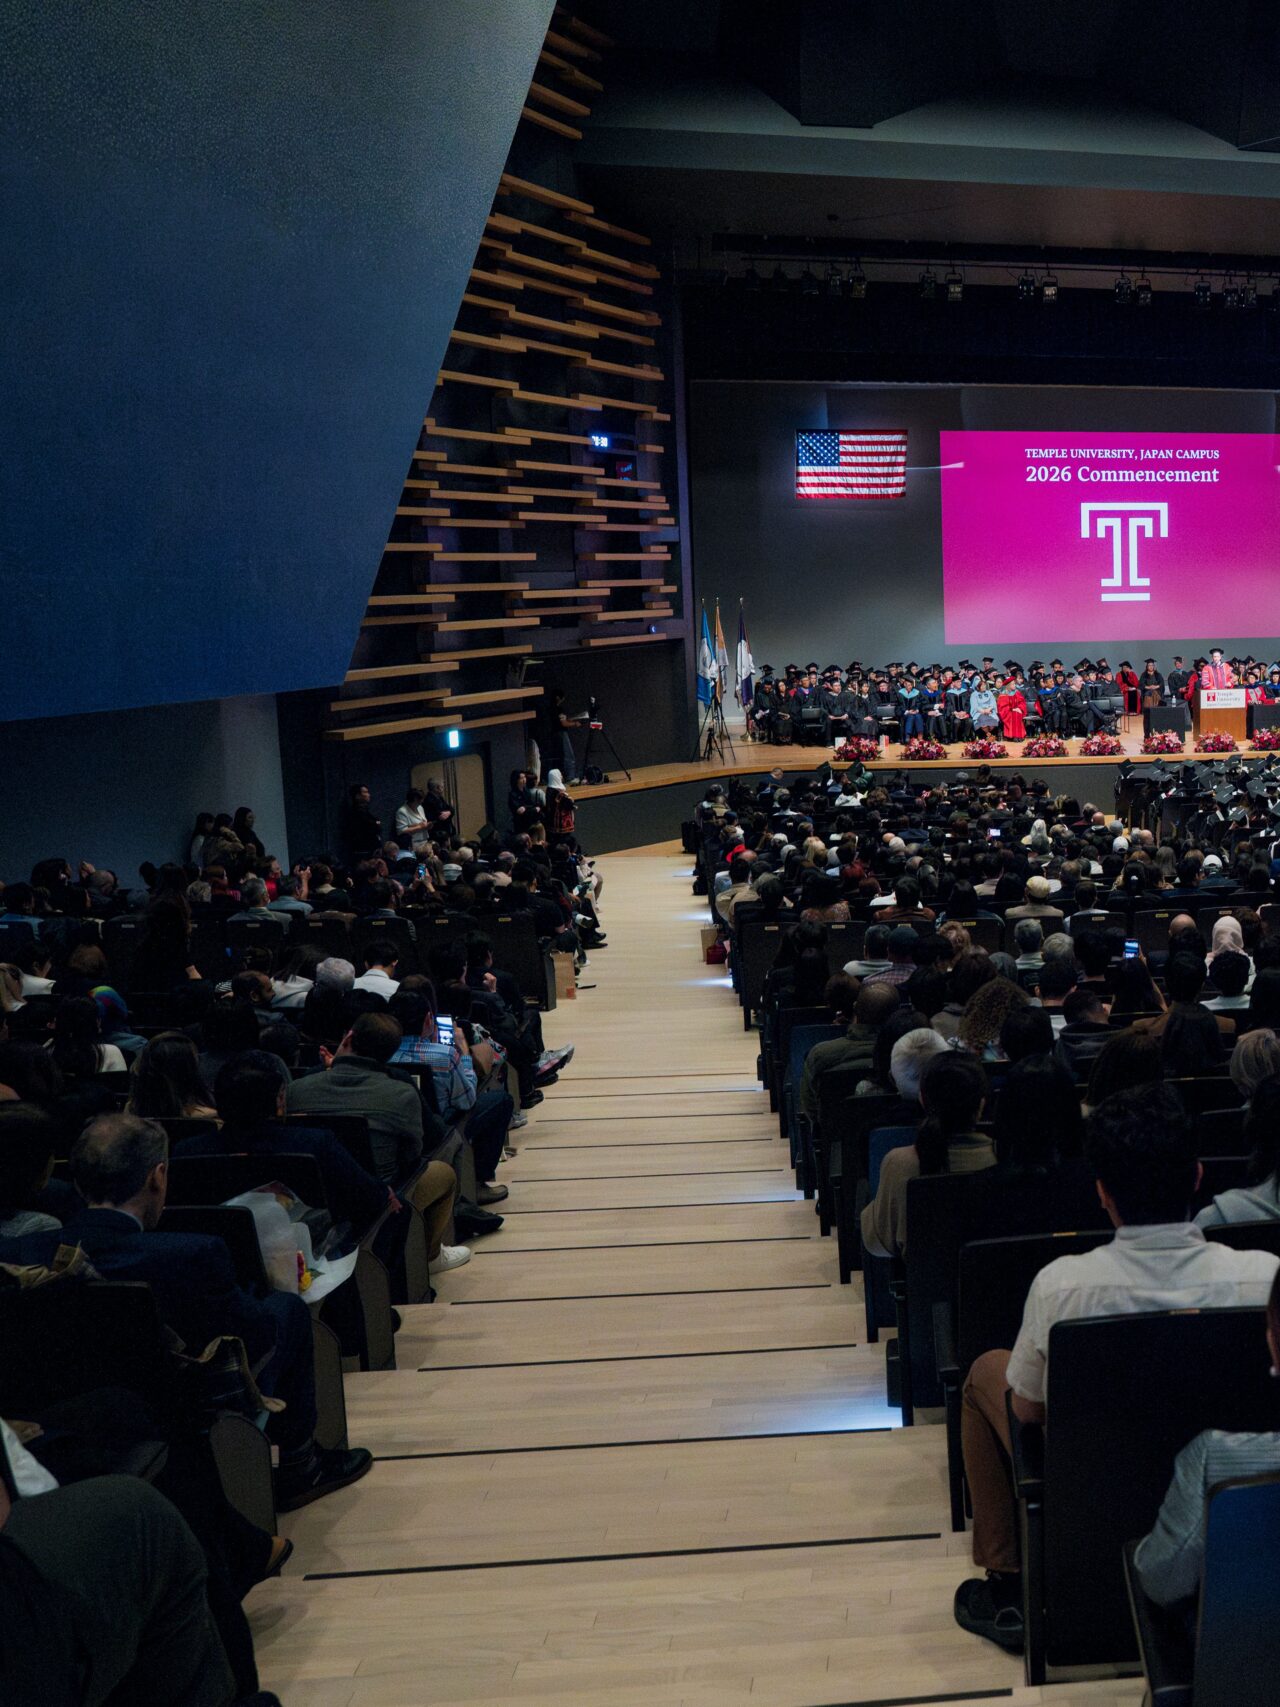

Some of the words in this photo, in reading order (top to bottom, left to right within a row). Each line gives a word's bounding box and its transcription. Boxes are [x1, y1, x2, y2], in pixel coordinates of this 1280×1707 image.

[1024, 448, 1068, 458] TEMPLE
[1069, 448, 1138, 460] UNIVERSITY,
[1140, 449, 1173, 460] JAPAN
[1175, 449, 1220, 459] CAMPUS
[1026, 465, 1072, 482] 2026
[1077, 465, 1220, 482] Commencement
